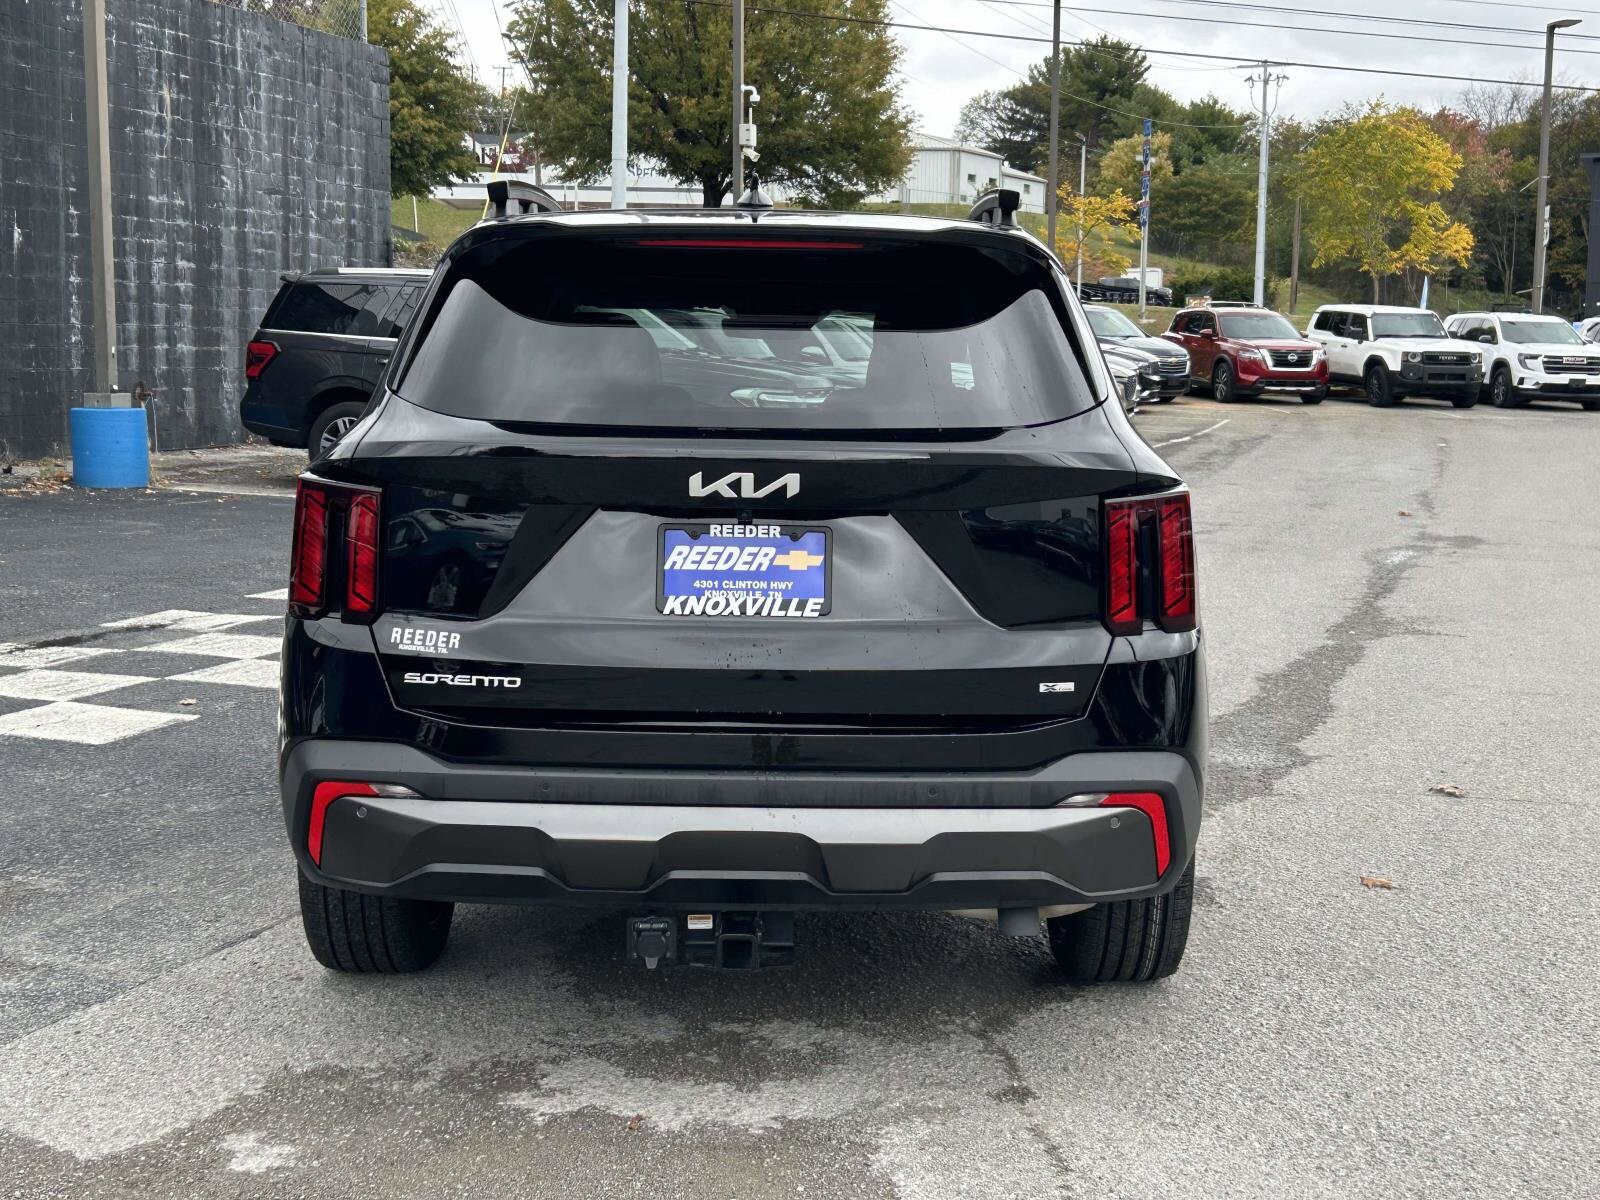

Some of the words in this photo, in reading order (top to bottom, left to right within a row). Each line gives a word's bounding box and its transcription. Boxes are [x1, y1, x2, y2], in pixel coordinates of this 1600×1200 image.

[688, 472, 800, 499] KIA
[709, 524, 781, 538] REEDER
[663, 545, 777, 571] REEDER
[693, 580, 719, 588] 4301
[722, 580, 767, 589] CLINTON
[770, 581, 794, 590] HWY
[662, 595, 825, 618] KNOXVILLE
[390, 627, 461, 648] REEDER
[403, 672, 522, 688] SORENTO
